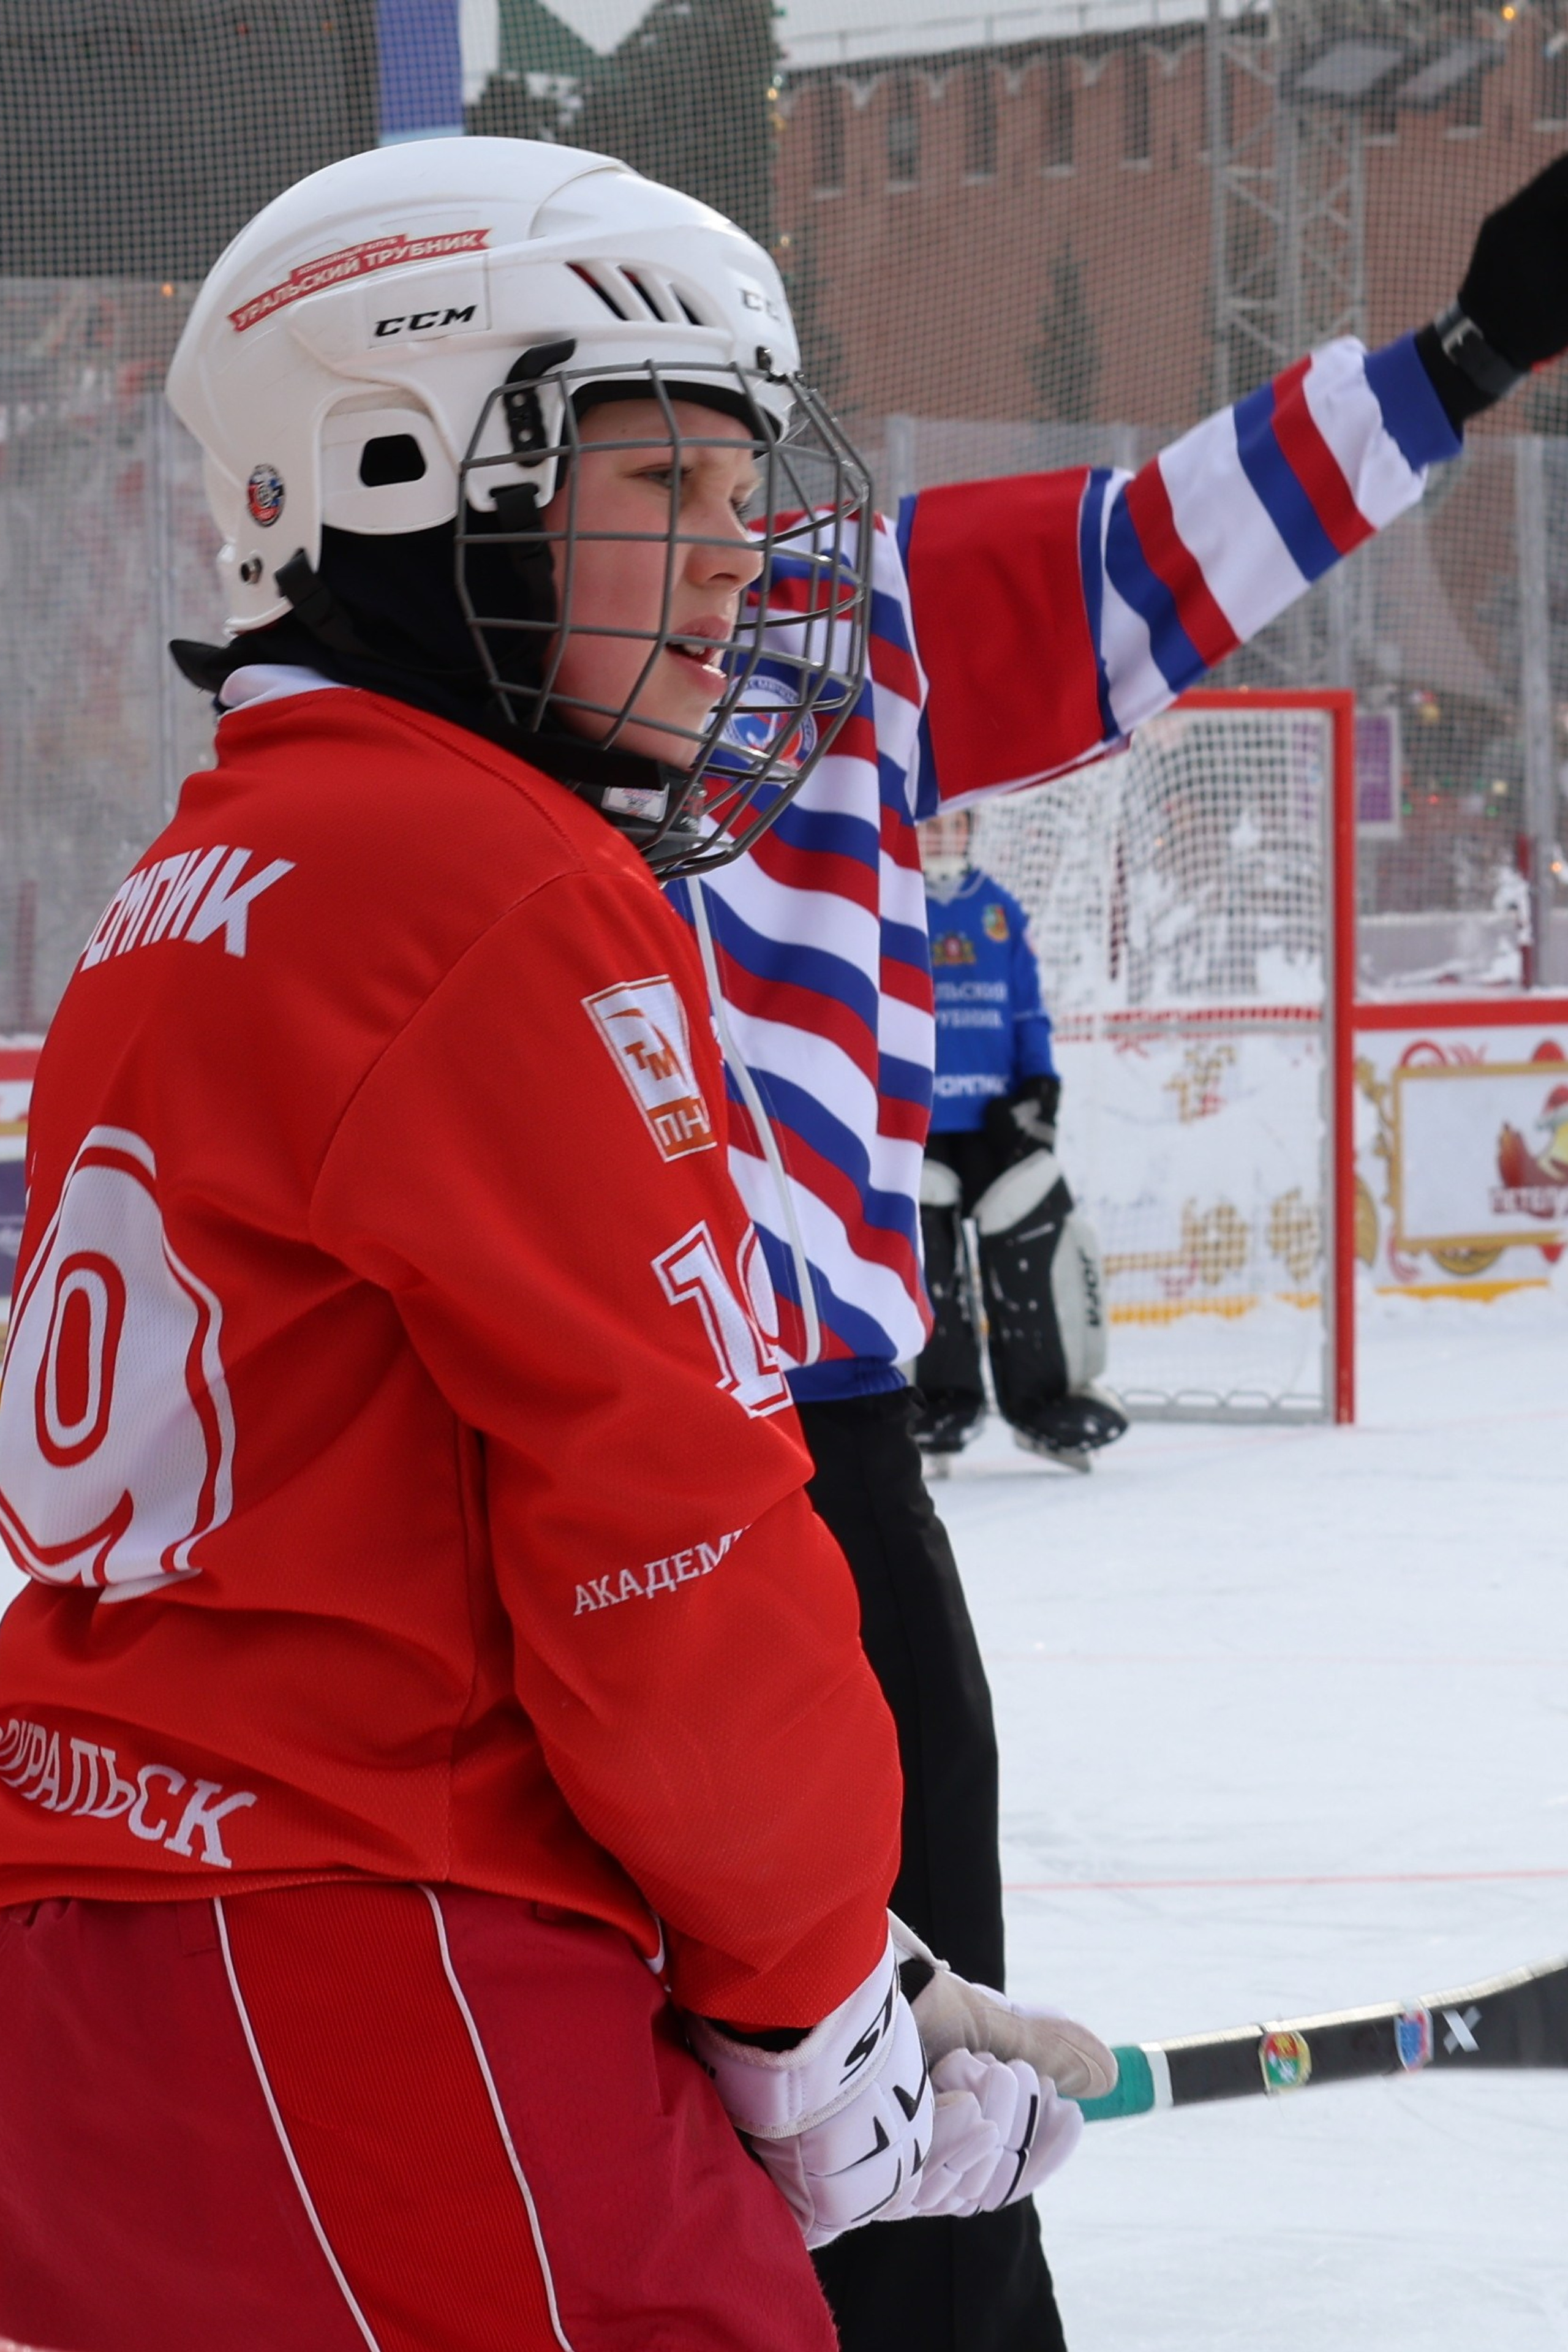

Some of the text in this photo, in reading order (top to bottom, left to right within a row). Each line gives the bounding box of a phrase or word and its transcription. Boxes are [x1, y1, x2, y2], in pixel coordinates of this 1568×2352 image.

[235, 232, 480, 328] УРАЛЬСКИЙ ТРУБНИК
[374, 304, 478, 338] CCM
[80, 844, 297, 973] ОМПИК
[573, 1523, 753, 1616] АКАДЕМ
[0, 1718, 258, 1869] ОУРАЛЬСК
